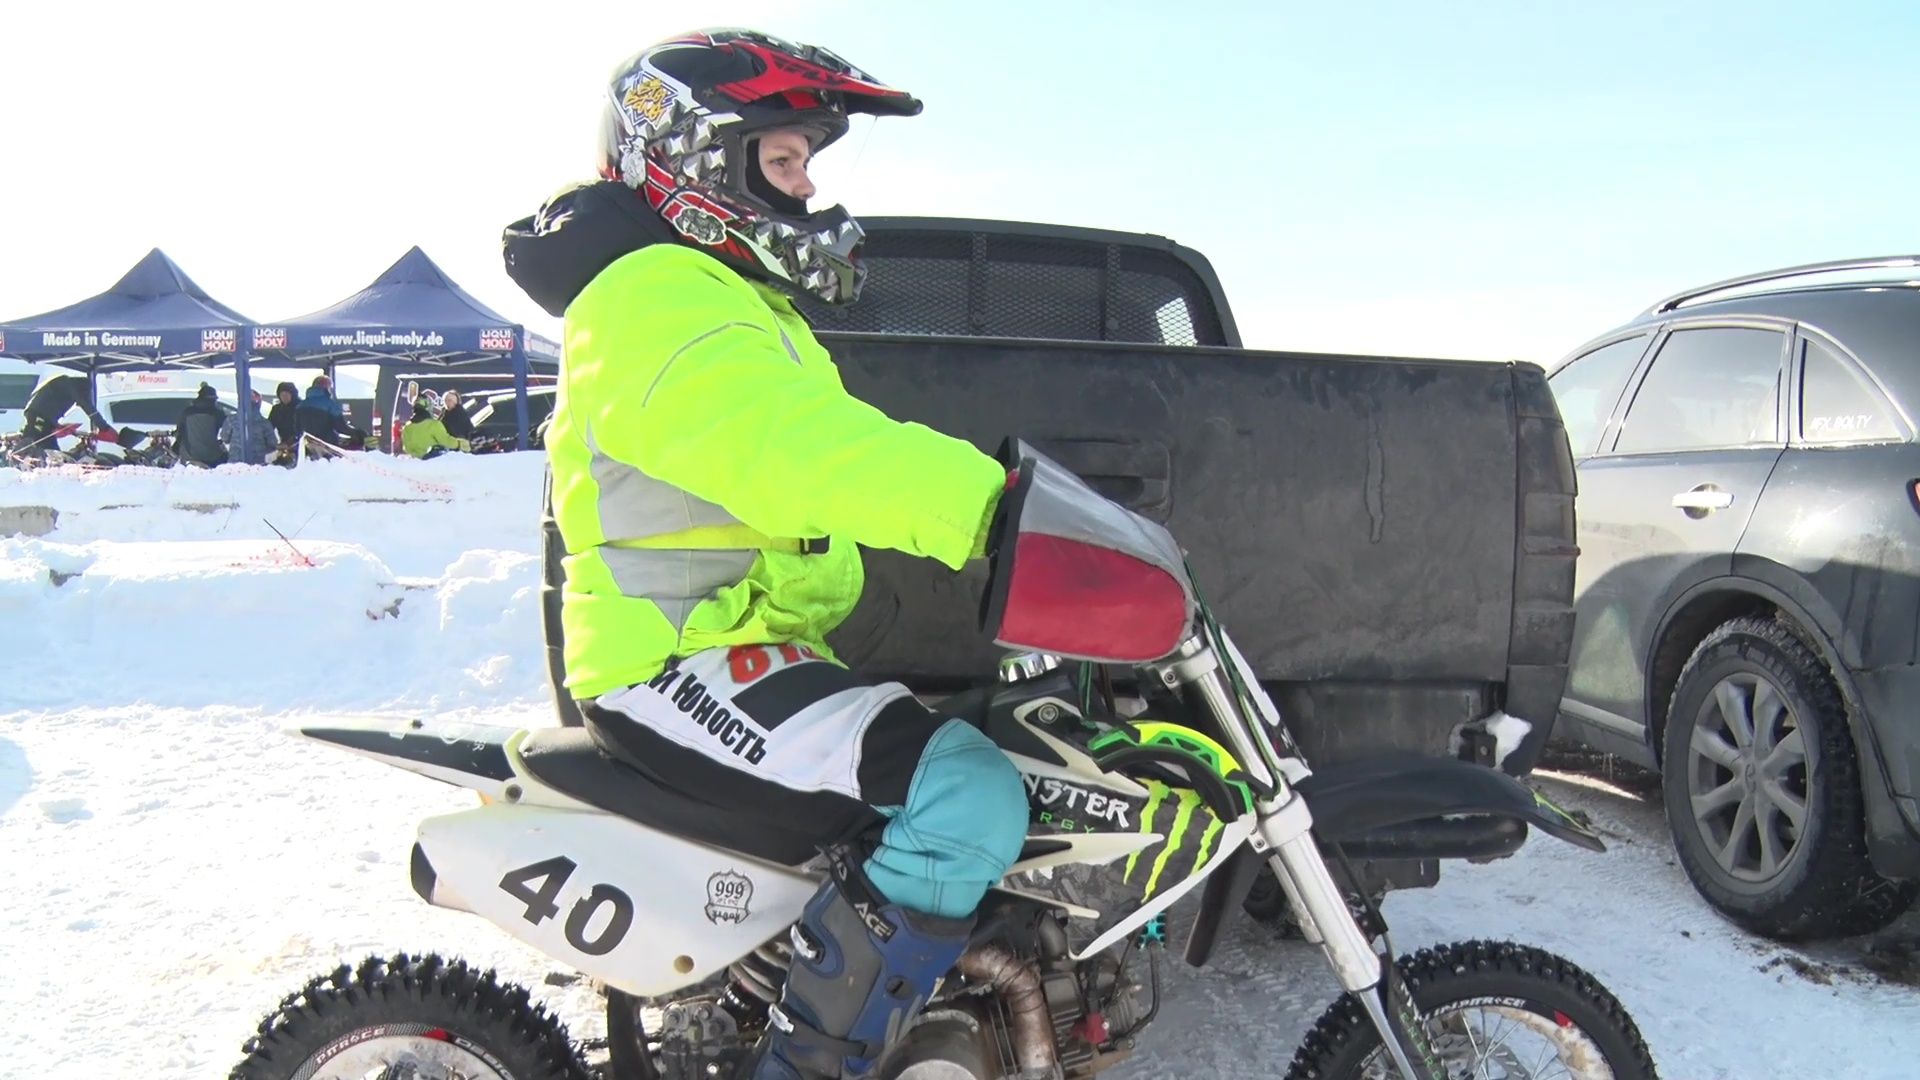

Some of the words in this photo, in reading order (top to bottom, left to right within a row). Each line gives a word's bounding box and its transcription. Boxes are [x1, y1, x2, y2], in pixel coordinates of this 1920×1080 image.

[203, 329, 234, 341] LIQUI
[254, 328, 285, 339] LIQUI
[321, 331, 444, 348] www.liqui-moly.de
[481, 329, 513, 340] LIQUI
[43, 332, 81, 347] Made
[85, 331, 98, 346] in
[101, 332, 161, 349] Germany
[203, 340, 234, 350] MOLY
[254, 337, 286, 348] MOLY
[481, 338, 513, 349] MOLY
[671, 672, 767, 766] ЮНОСТЬ
[715, 880, 744, 899] 999
[498, 854, 634, 957] 40
